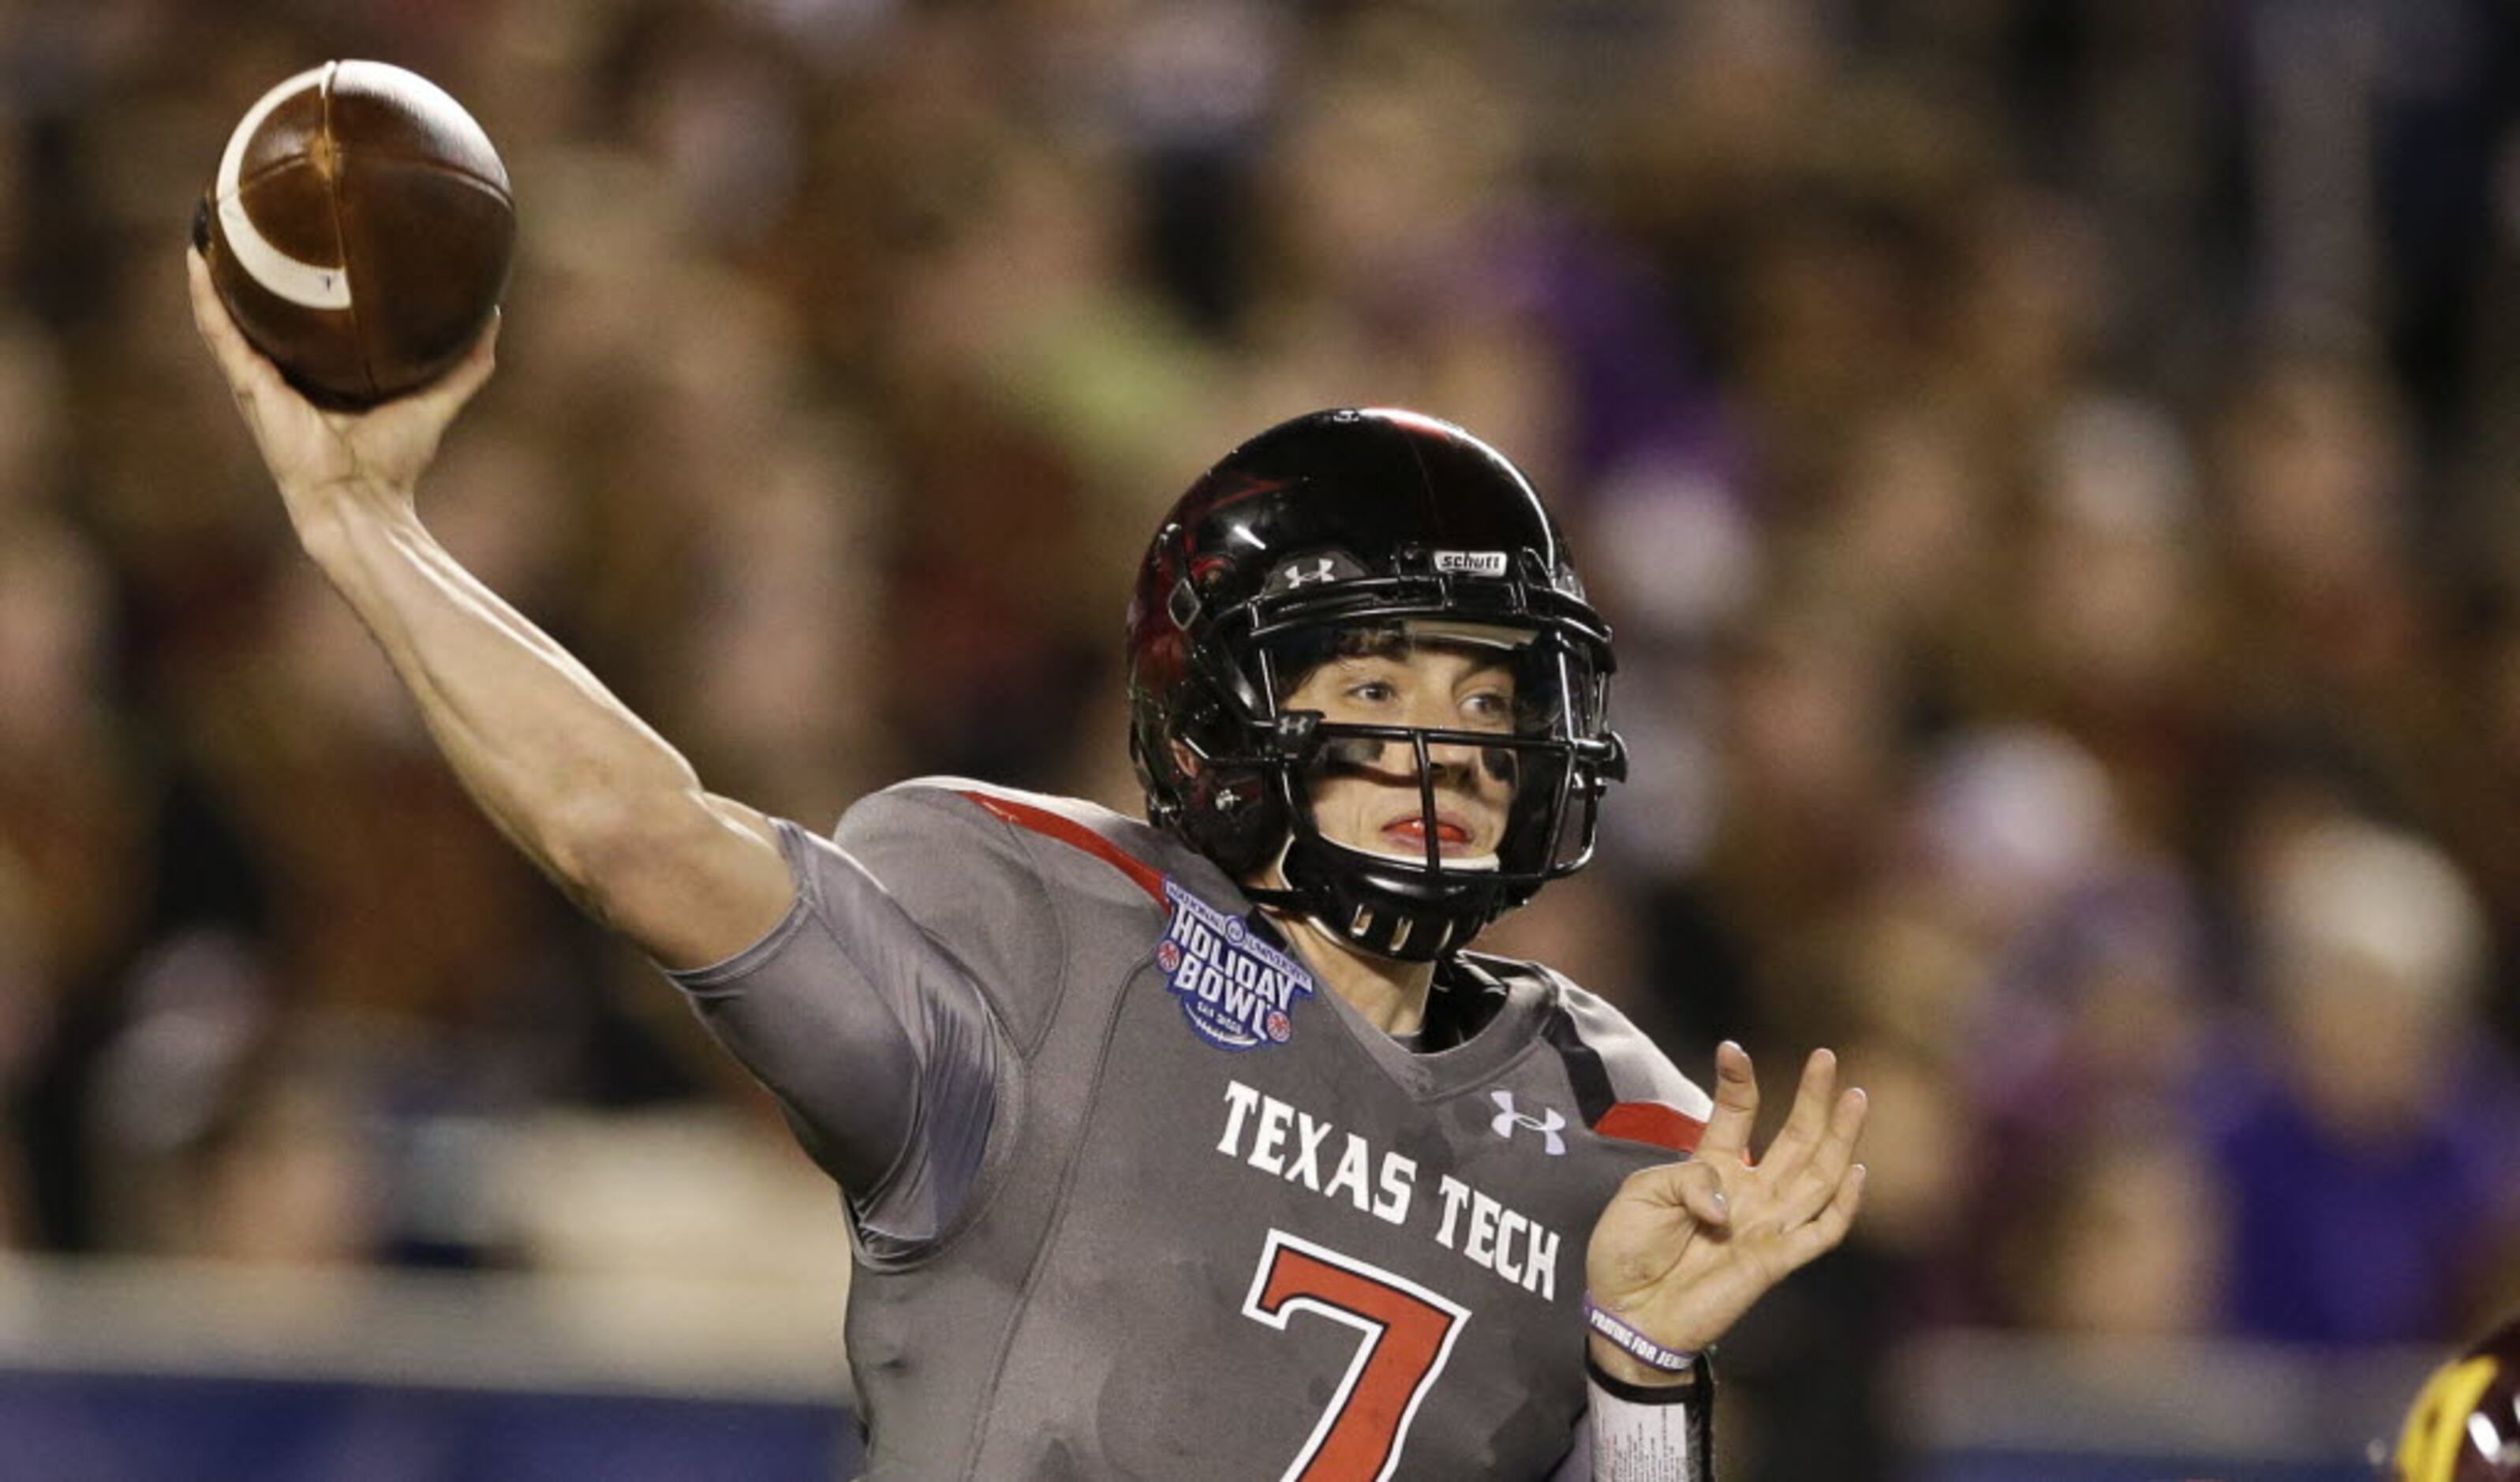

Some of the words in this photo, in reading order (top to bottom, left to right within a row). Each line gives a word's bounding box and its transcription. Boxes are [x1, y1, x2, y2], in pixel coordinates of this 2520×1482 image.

[1441, 551, 1500, 569] schutt
[1171, 904, 1296, 1011] HOLIDAY
[1174, 952, 1268, 1041] BOWL
[1216, 1080, 1418, 1225] TEXAS
[1434, 1173, 1561, 1302] TECH
[1241, 1227, 1472, 1482] 7
[1631, 1336, 1658, 1362] FOR
